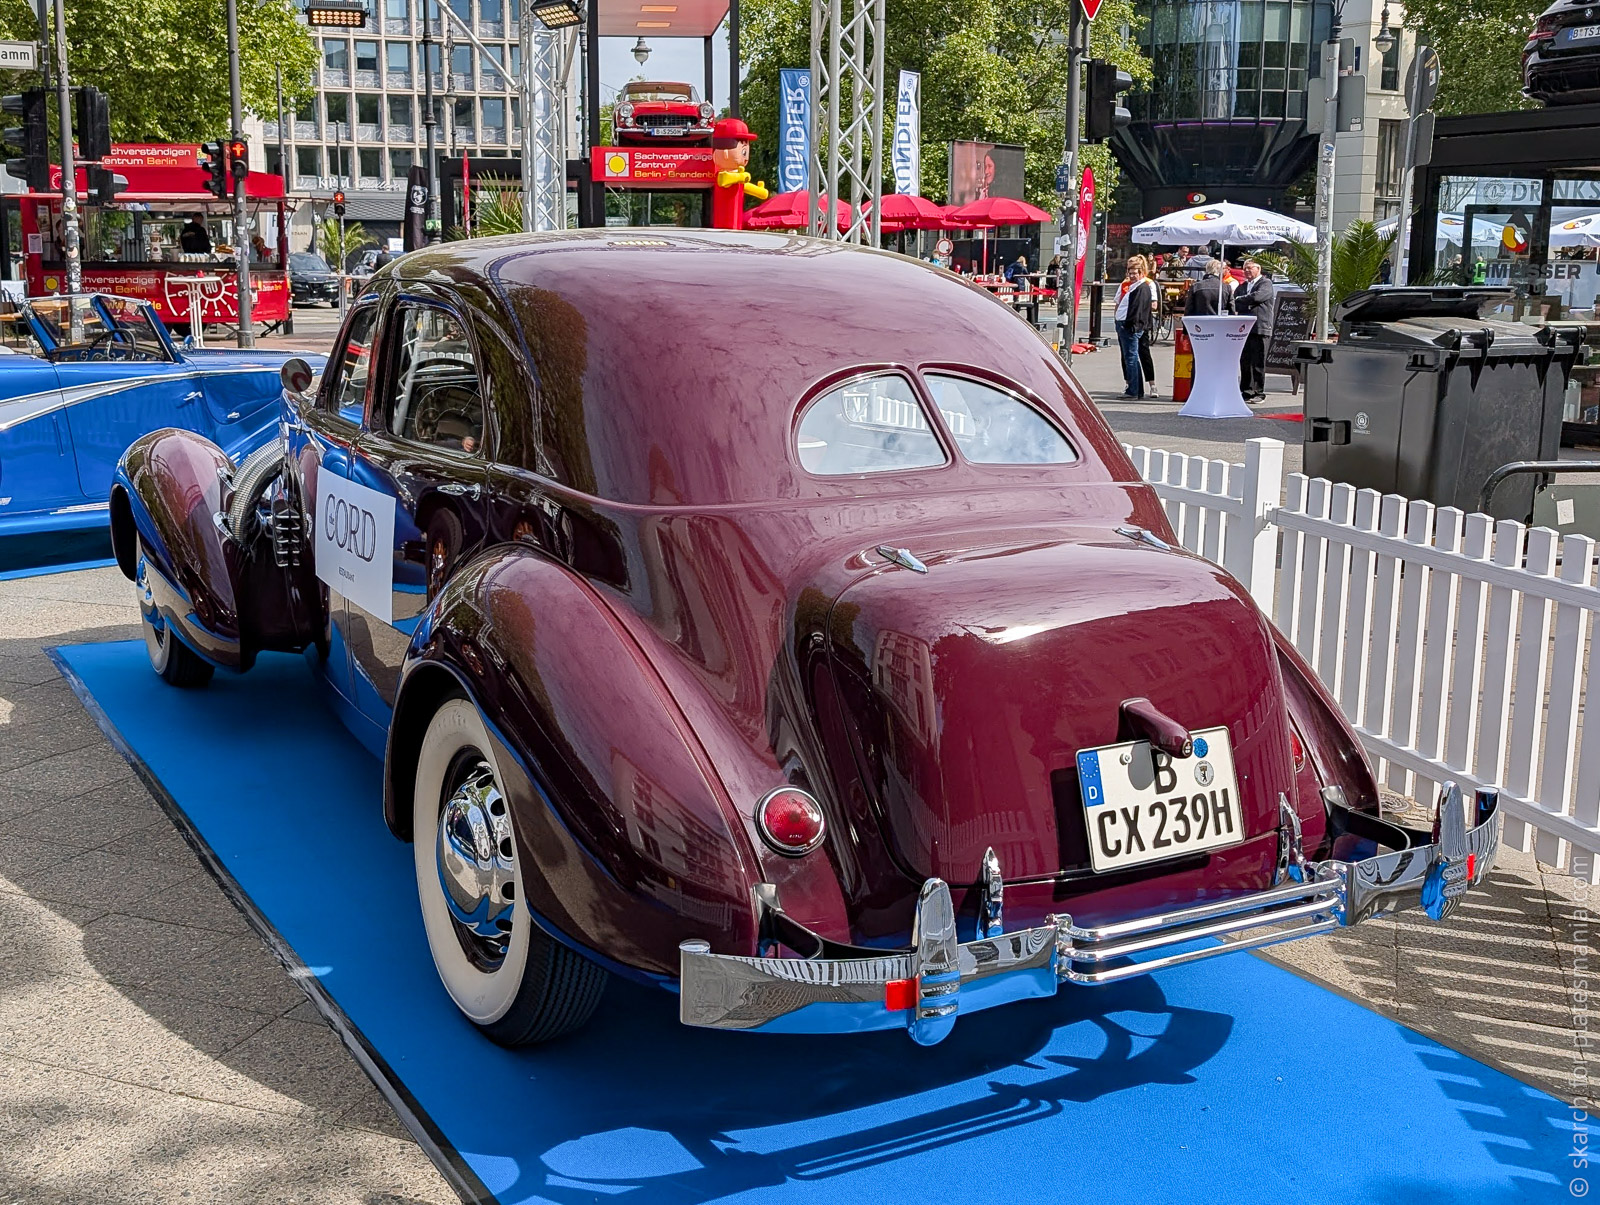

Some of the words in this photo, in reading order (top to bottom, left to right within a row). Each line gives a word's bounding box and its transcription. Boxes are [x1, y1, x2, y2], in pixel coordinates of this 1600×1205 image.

[3, 51, 30, 60] amm
[110, 147, 191, 157] chverständigen
[634, 152, 713, 161] Sachverständige
[101, 157, 143, 165] entrum
[147, 157, 178, 165] Berlin
[634, 161, 677, 169] Zentrum
[634, 170, 662, 178] Berlin
[115, 286, 147, 294] Berlin
[325, 493, 377, 563] CORD
[1154, 751, 1178, 795] B
[1088, 785, 1098, 800] D
[1098, 805, 1146, 858] CX
[1149, 788, 1234, 849] 239H
